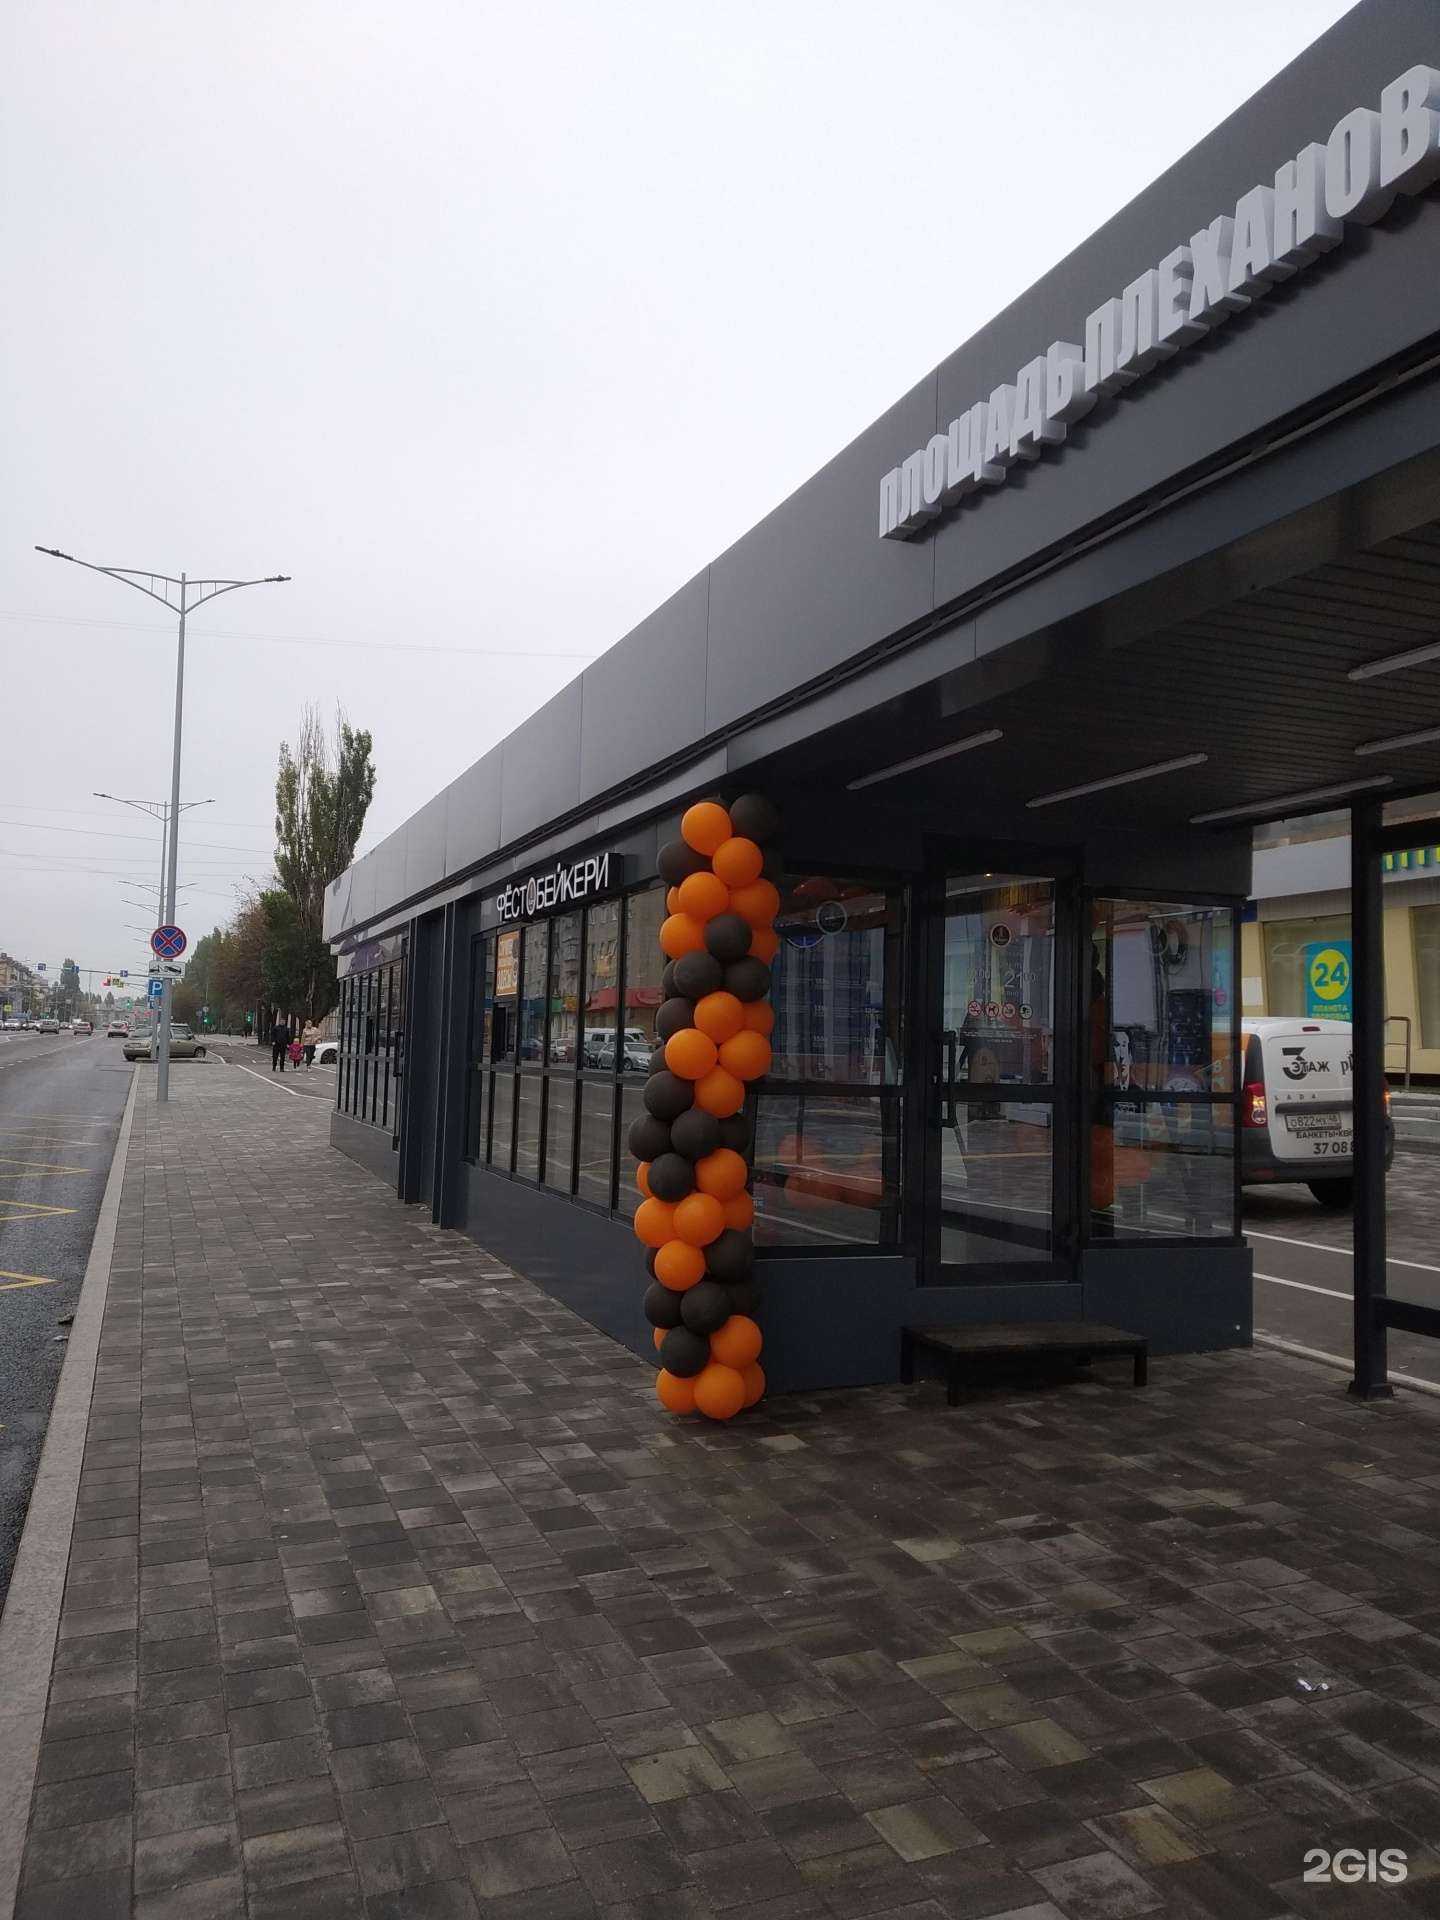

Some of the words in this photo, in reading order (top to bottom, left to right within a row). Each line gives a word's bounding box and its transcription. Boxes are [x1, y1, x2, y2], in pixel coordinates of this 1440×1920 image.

[880, 340, 1087, 539] ПЛОЩАДЬ
[1314, 961, 1347, 988] 24
[1313, 1142, 1329, 1155] 37
[1332, 1141, 1348, 1154] 08
